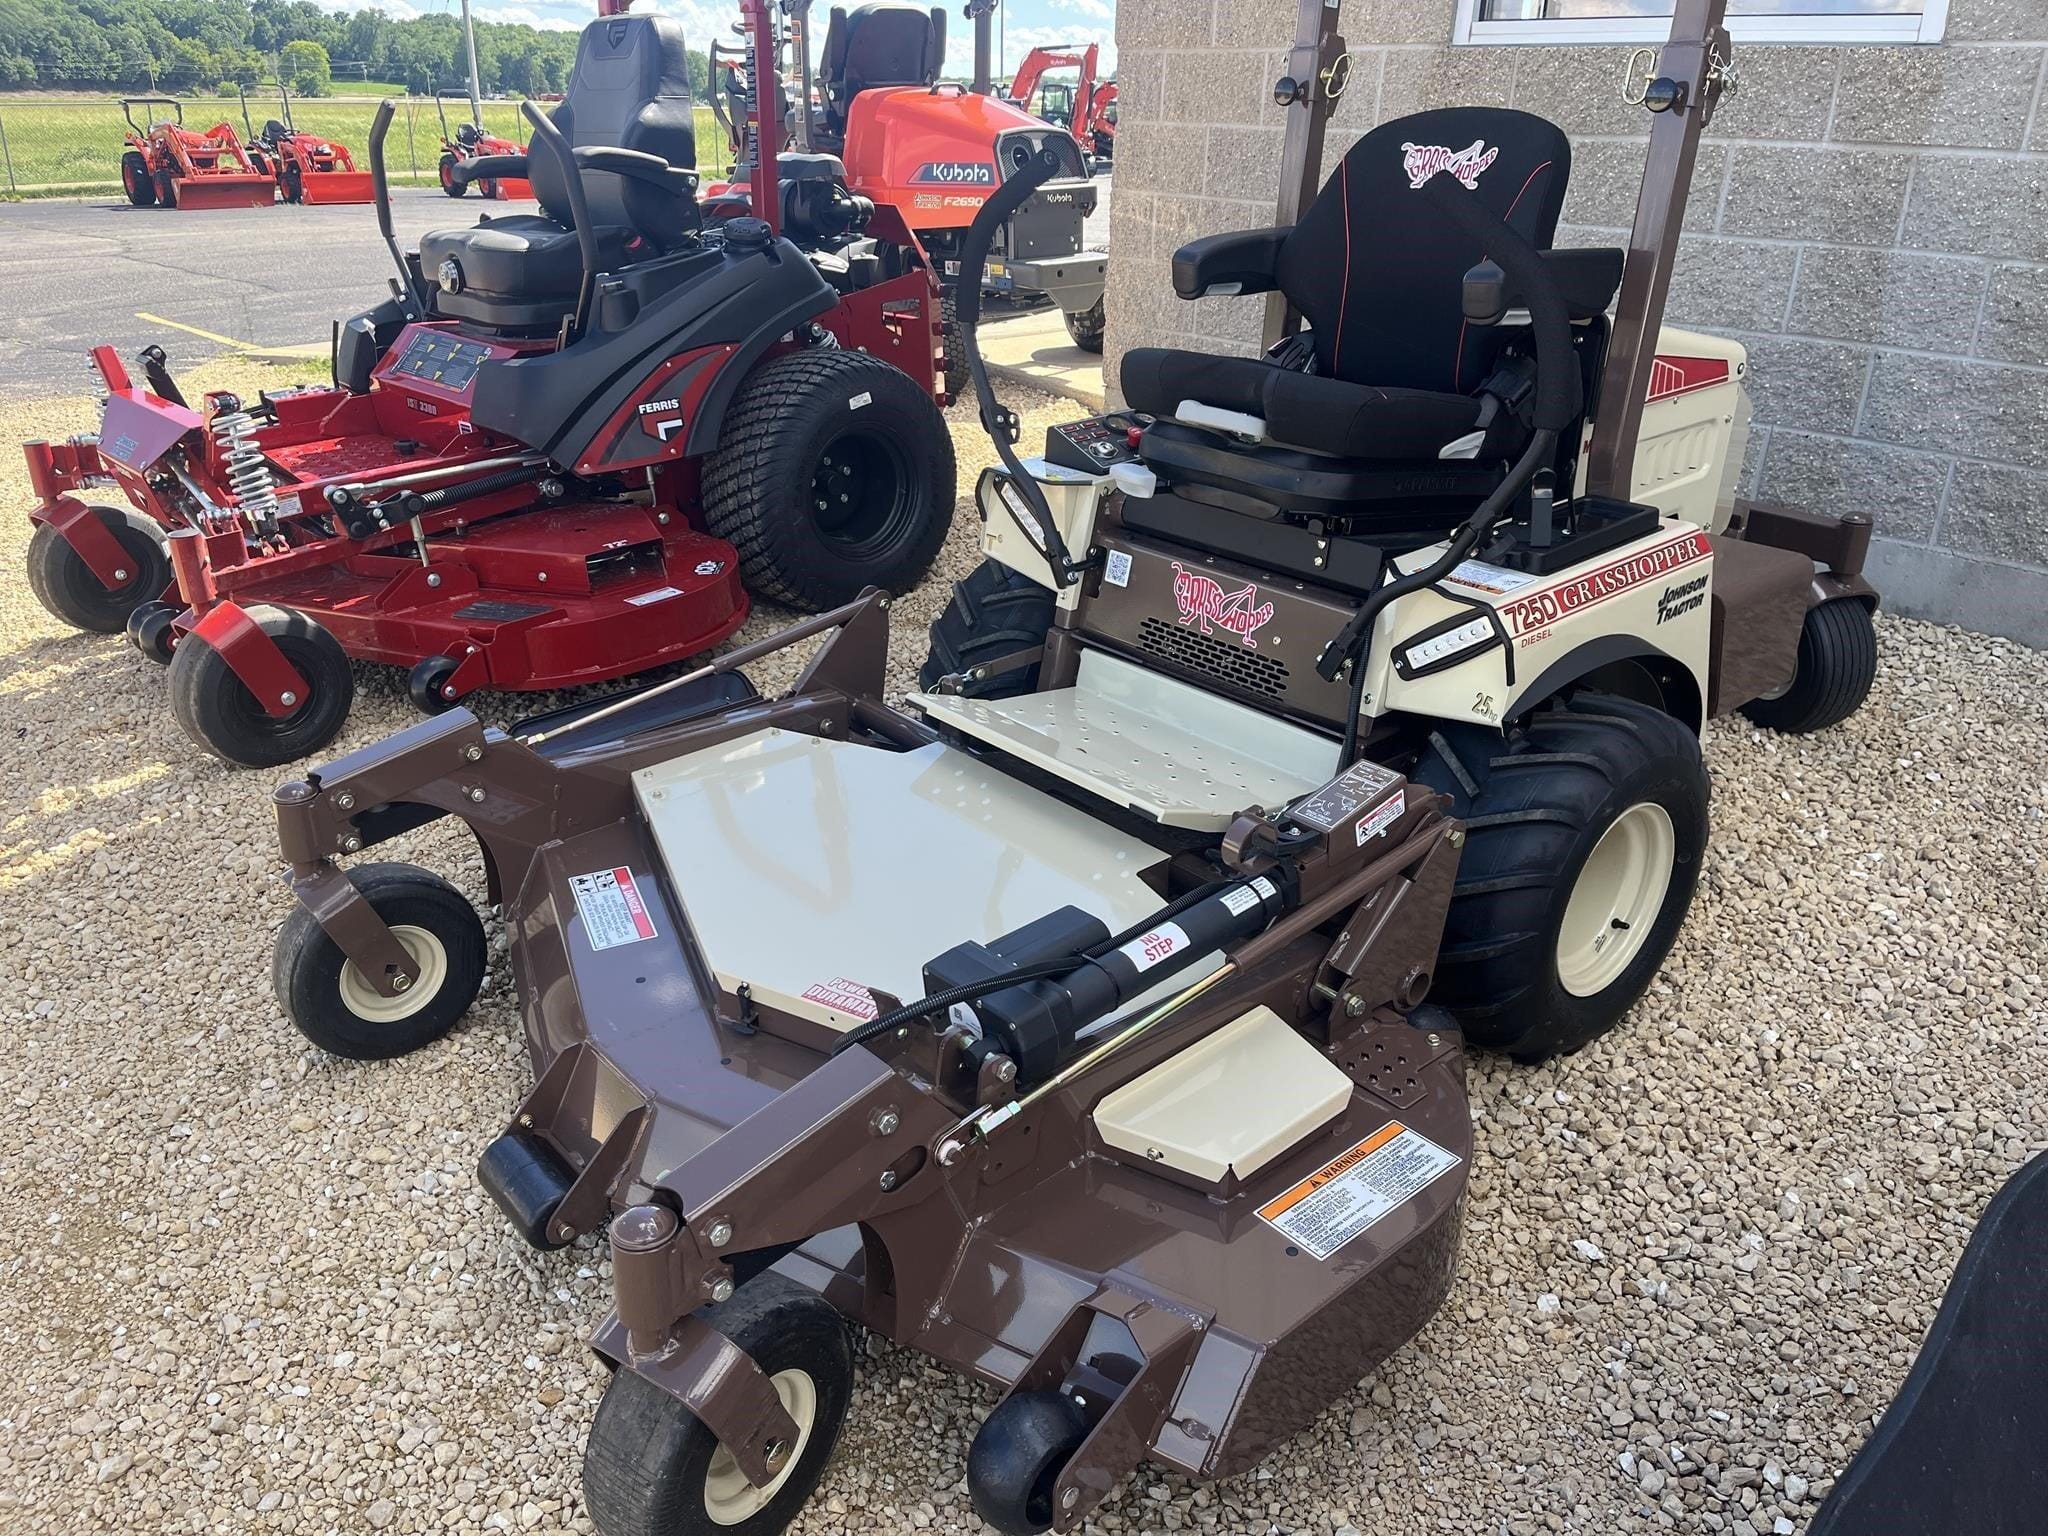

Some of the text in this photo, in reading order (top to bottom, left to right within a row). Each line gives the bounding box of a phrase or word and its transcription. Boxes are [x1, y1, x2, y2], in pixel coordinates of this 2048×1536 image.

[933, 163, 990, 182] Kubota
[944, 195, 984, 207] F2690
[1047, 193, 1073, 203] Kubota
[638, 398, 680, 415] FERRIS
[1503, 592, 1559, 634] 725D
[1562, 537, 1701, 609] GRASSHOPPER
[1658, 575, 1709, 609] JOHNSON
[1656, 593, 1704, 626] TRACTOR
[1521, 628, 1553, 649] DIESEL
[1140, 932, 1160, 947] NO
[1145, 937, 1174, 962] STEP
[804, 983, 877, 1017] DURAMAX
[1319, 1148, 1367, 1180] WARNING
